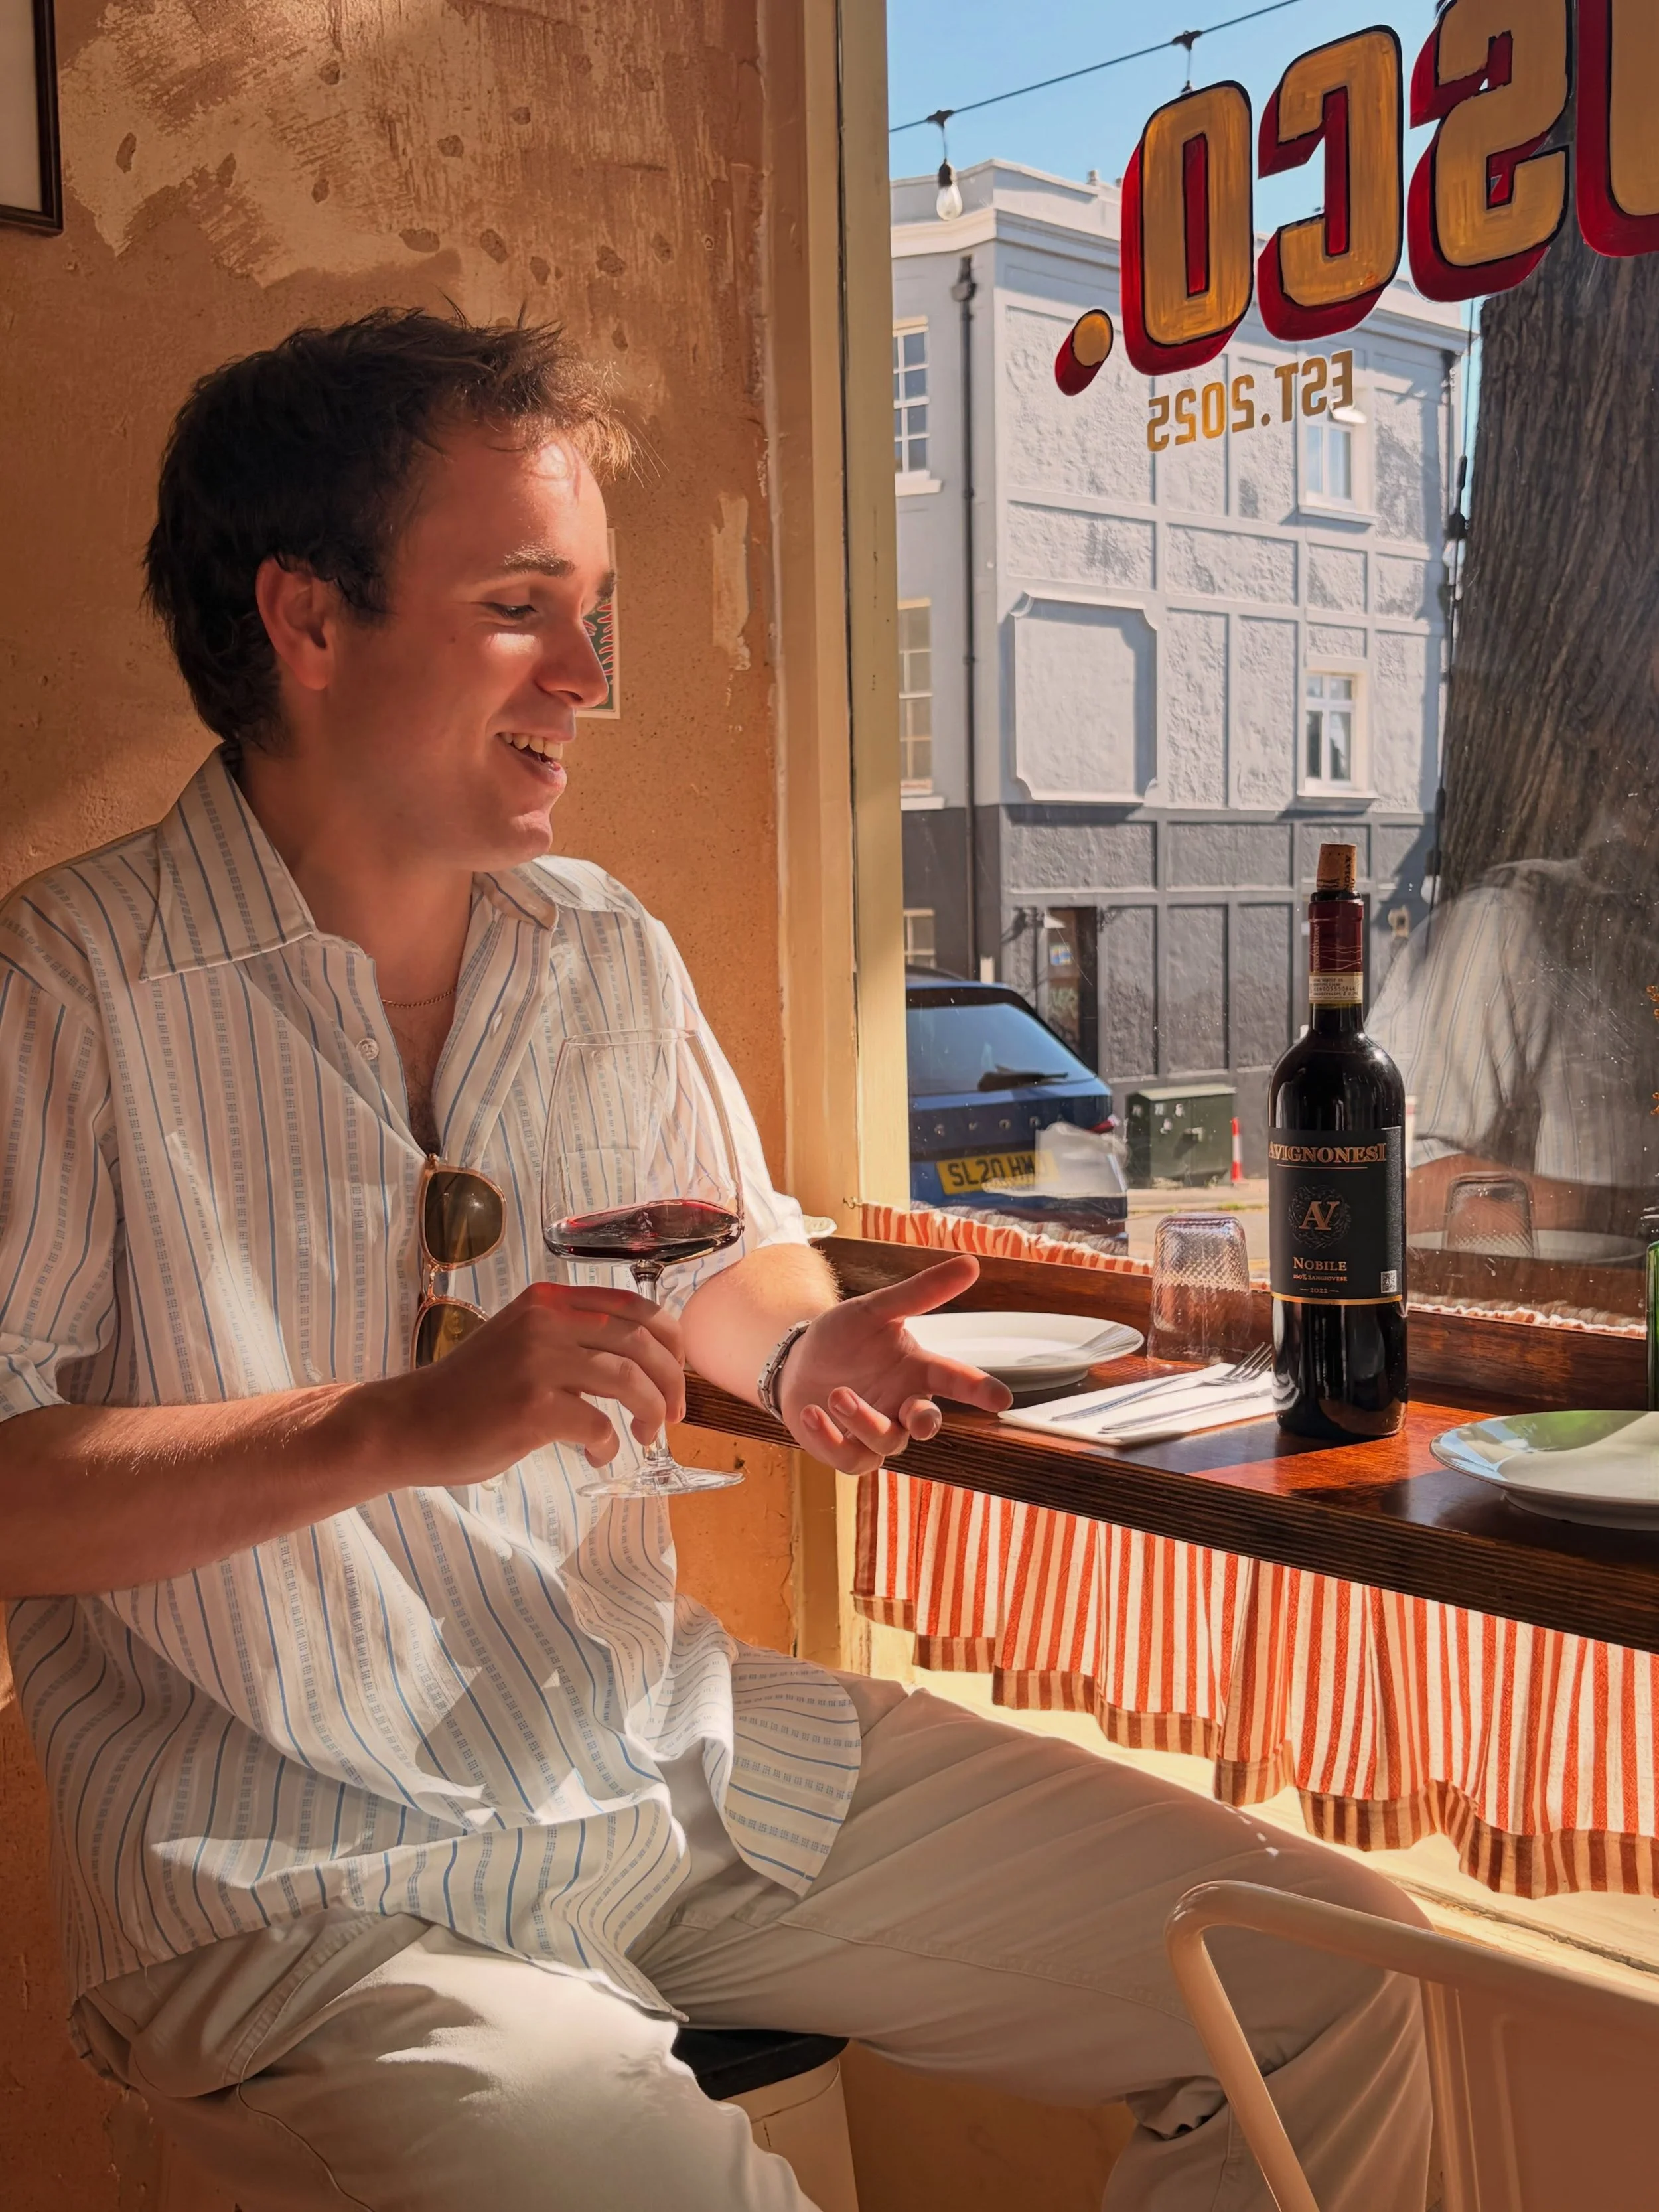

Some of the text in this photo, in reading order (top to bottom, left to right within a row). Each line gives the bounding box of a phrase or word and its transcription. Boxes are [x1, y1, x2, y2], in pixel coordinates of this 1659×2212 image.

[1269, 1141, 1387, 1163] AVIGNONESI
[948, 1158, 1005, 1186] SL20
[1299, 1201, 1340, 1230] AV
[1293, 1256, 1348, 1272] NOBILE
